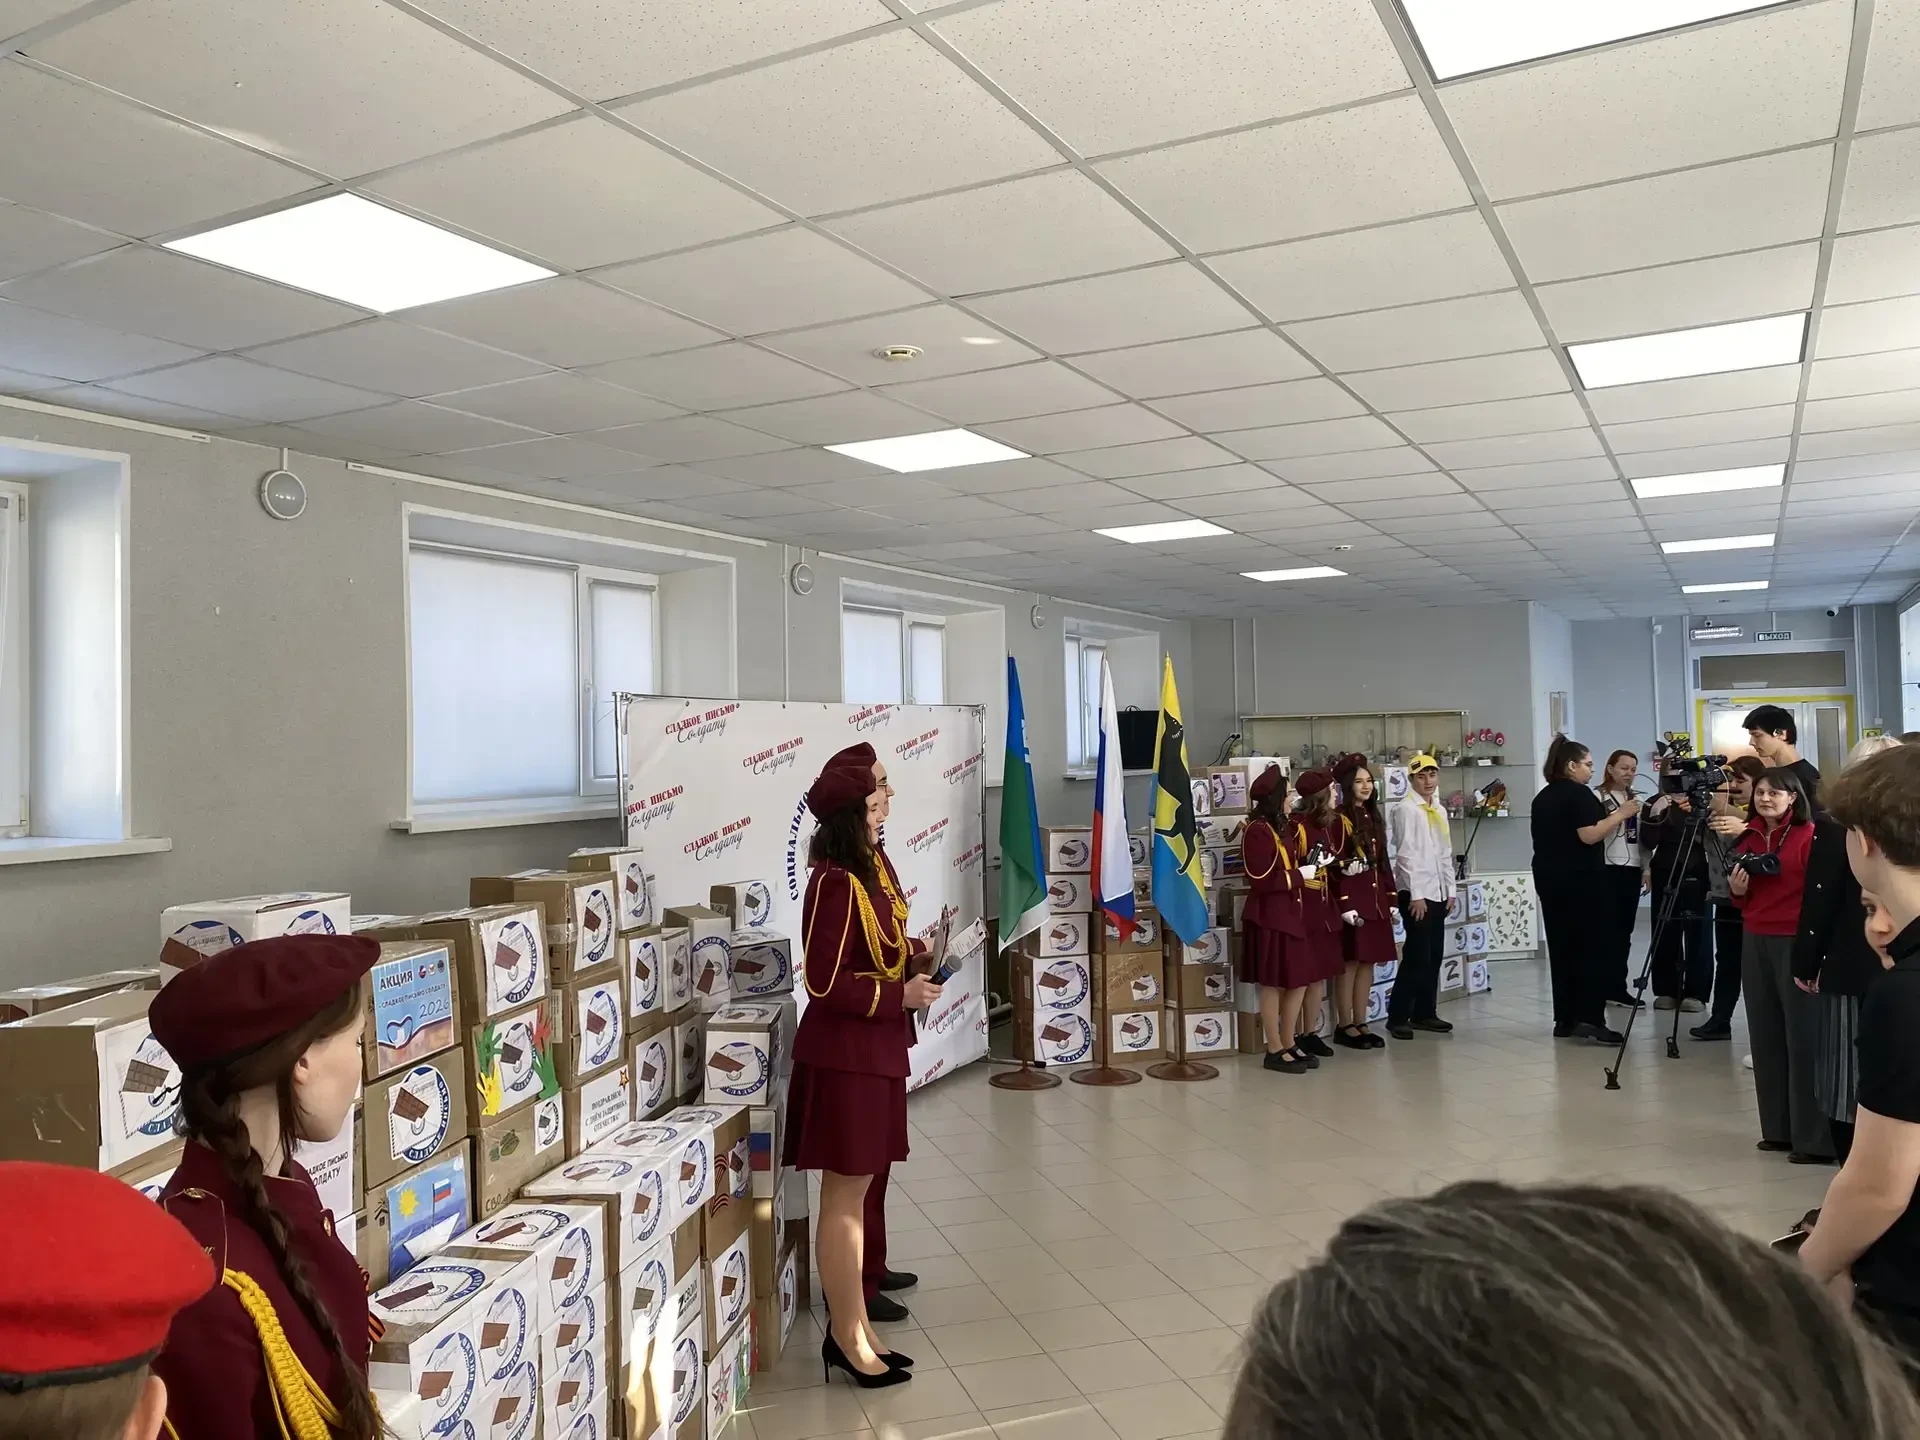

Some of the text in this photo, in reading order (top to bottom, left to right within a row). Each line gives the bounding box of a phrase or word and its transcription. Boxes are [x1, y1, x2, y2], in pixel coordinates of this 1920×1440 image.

[665, 703, 735, 735] СЛАДКОЕ ПИСЬМО
[743, 736, 804, 768] СЛАДКОЕ ПИСЬМО
[650, 785, 684, 806] ПИСЬМО
[684, 816, 752, 854] СЛАДКОЕ ПИСЬМО
[380, 970, 414, 990] АКЦИЯ
[419, 998, 451, 1019] 2026
[327, 1151, 349, 1167] ПИСЬМО
[313, 1166, 341, 1187] ОЛДАТУ
